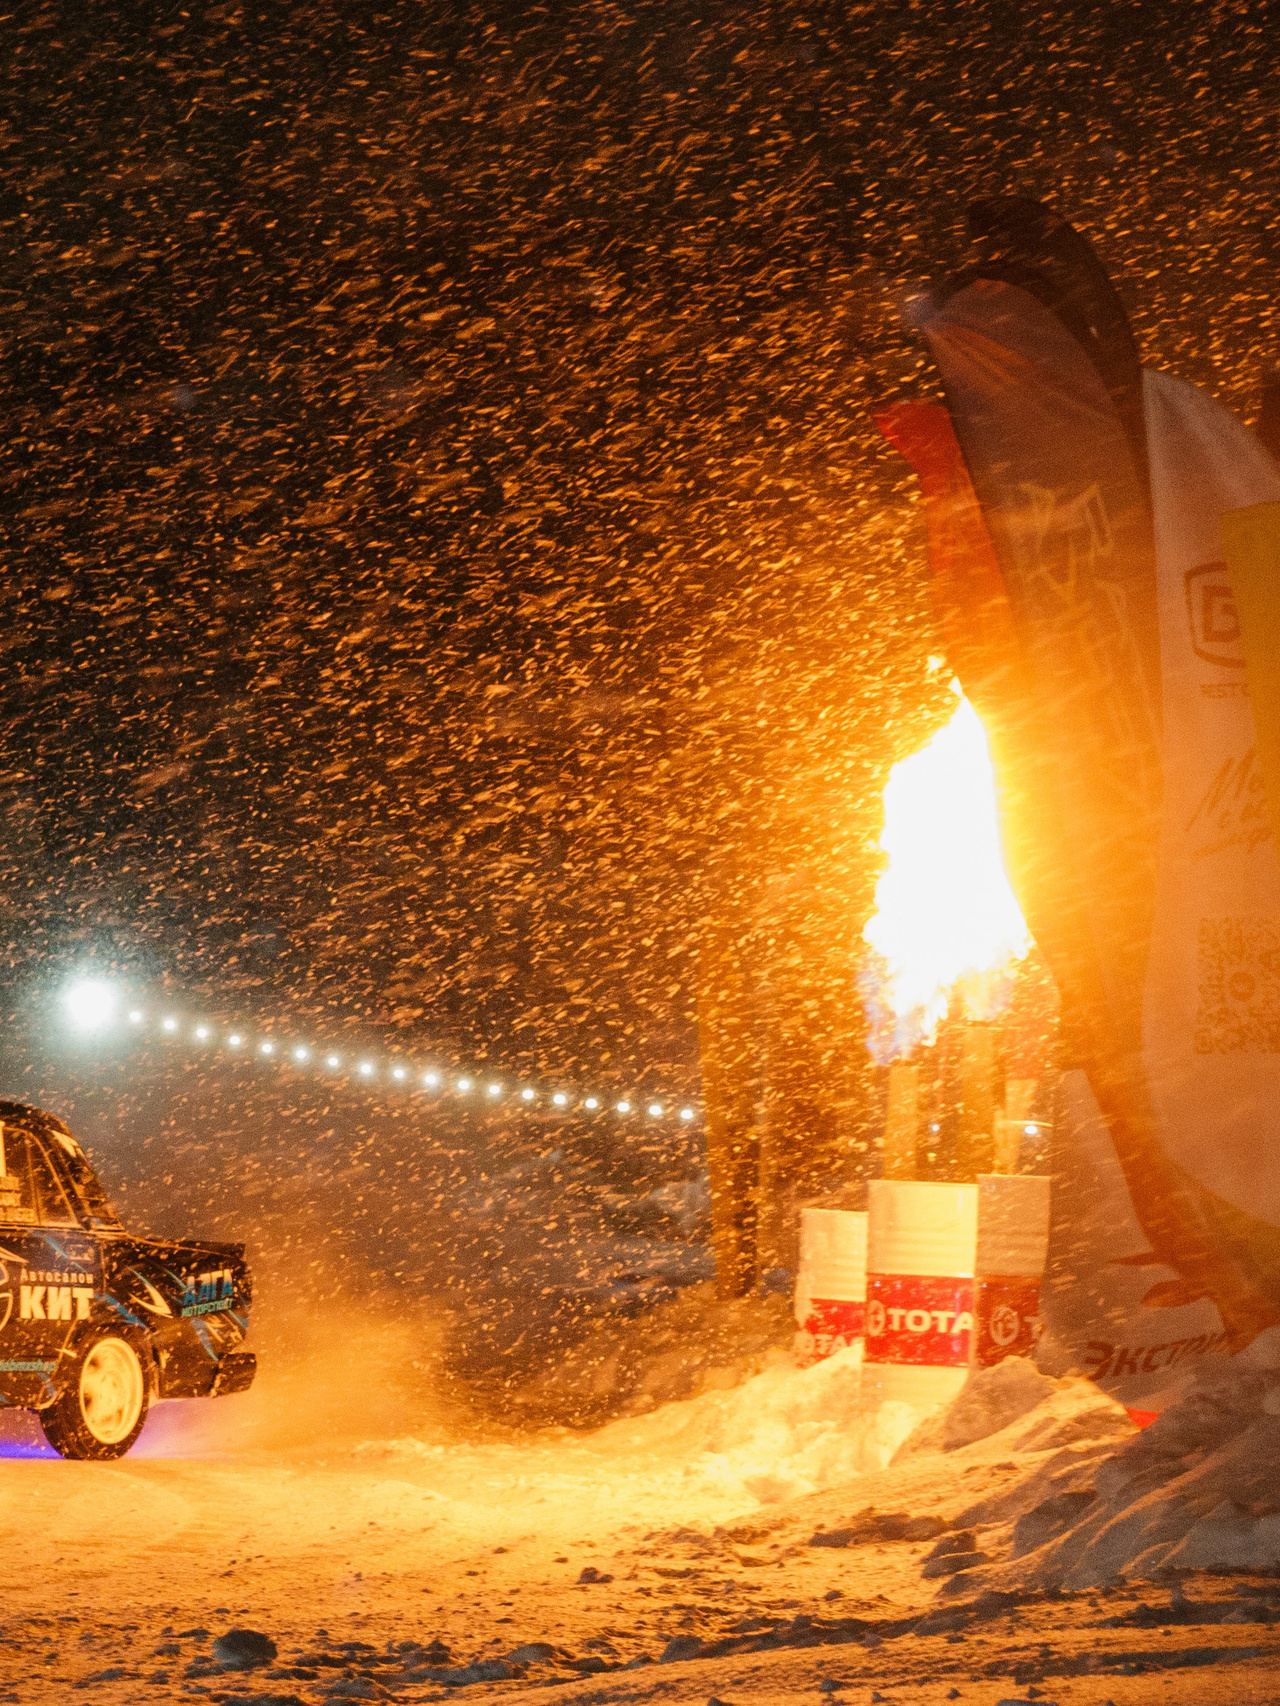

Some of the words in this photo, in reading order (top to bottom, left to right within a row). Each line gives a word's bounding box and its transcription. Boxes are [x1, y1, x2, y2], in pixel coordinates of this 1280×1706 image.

[20, 1268, 94, 1285] Автосалон
[182, 1268, 234, 1306] АЛГА
[20, 1285, 95, 1320] КИТ
